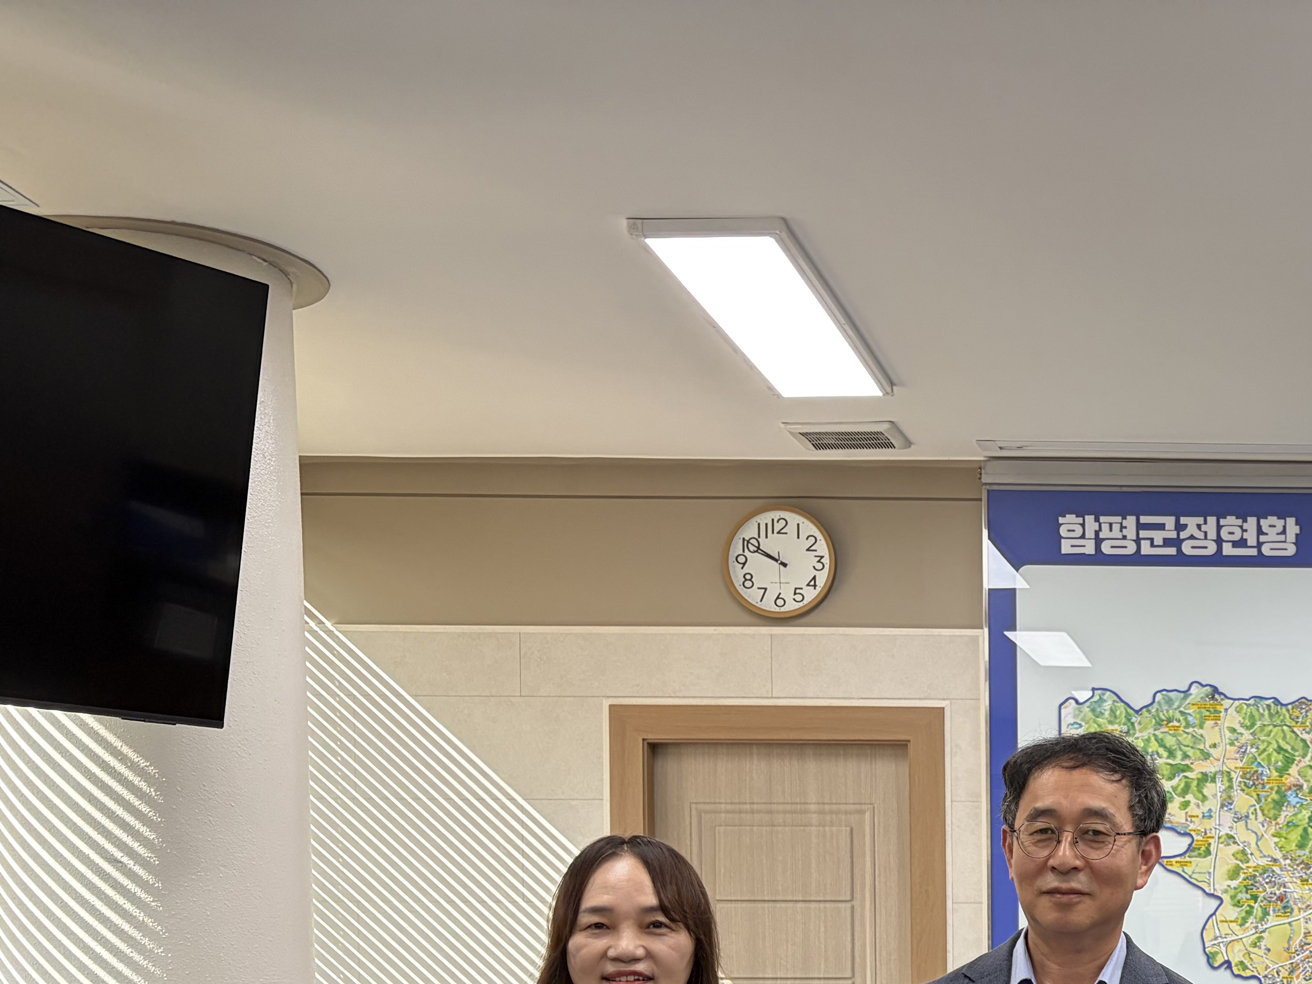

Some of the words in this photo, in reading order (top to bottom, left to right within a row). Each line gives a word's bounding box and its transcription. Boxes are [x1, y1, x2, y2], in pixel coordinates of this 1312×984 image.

[758, 522, 768, 539] 11
[772, 518, 788, 535] 12
[796, 523, 800, 539] 1
[805, 535, 818, 552] 2
[1058, 514, 1300, 557] 함평군정현황
[742, 537, 761, 554] 10
[735, 553, 748, 570] 9
[812, 555, 825, 572] 3
[742, 572, 754, 589] 8
[805, 575, 818, 590] 4
[757, 587, 768, 603] 7
[774, 592, 786, 608] 6
[792, 587, 805, 603] 5
